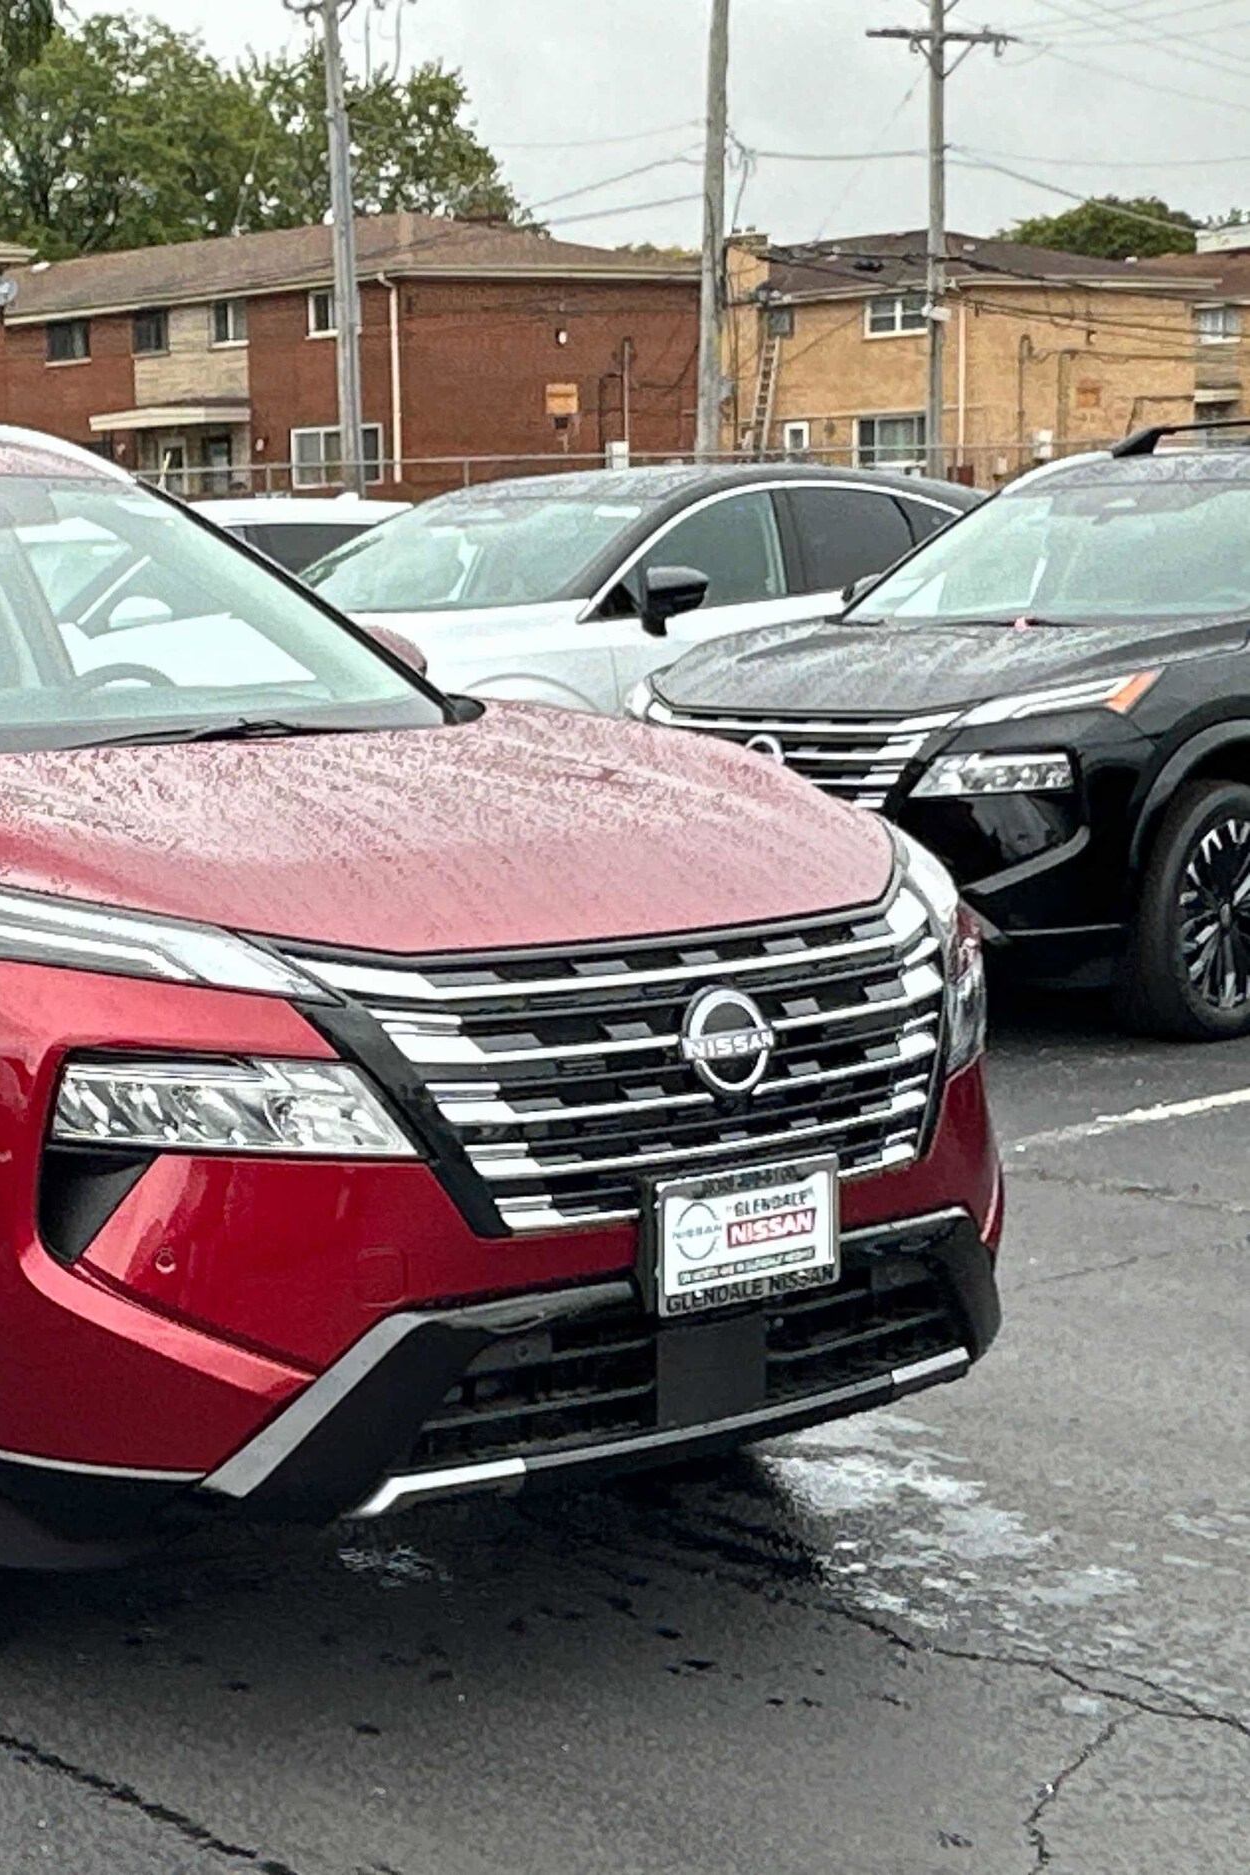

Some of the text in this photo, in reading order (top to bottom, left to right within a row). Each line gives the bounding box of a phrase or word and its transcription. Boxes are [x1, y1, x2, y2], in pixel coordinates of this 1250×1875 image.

[685, 1031, 774, 1059] NISSAN
[734, 1195, 807, 1217] GLENDALE
[672, 1224, 723, 1240] NISSAN
[730, 1212, 814, 1245] NISSAN
[666, 1280, 762, 1313] GLENDALE
[769, 1265, 836, 1294] NISSAN
